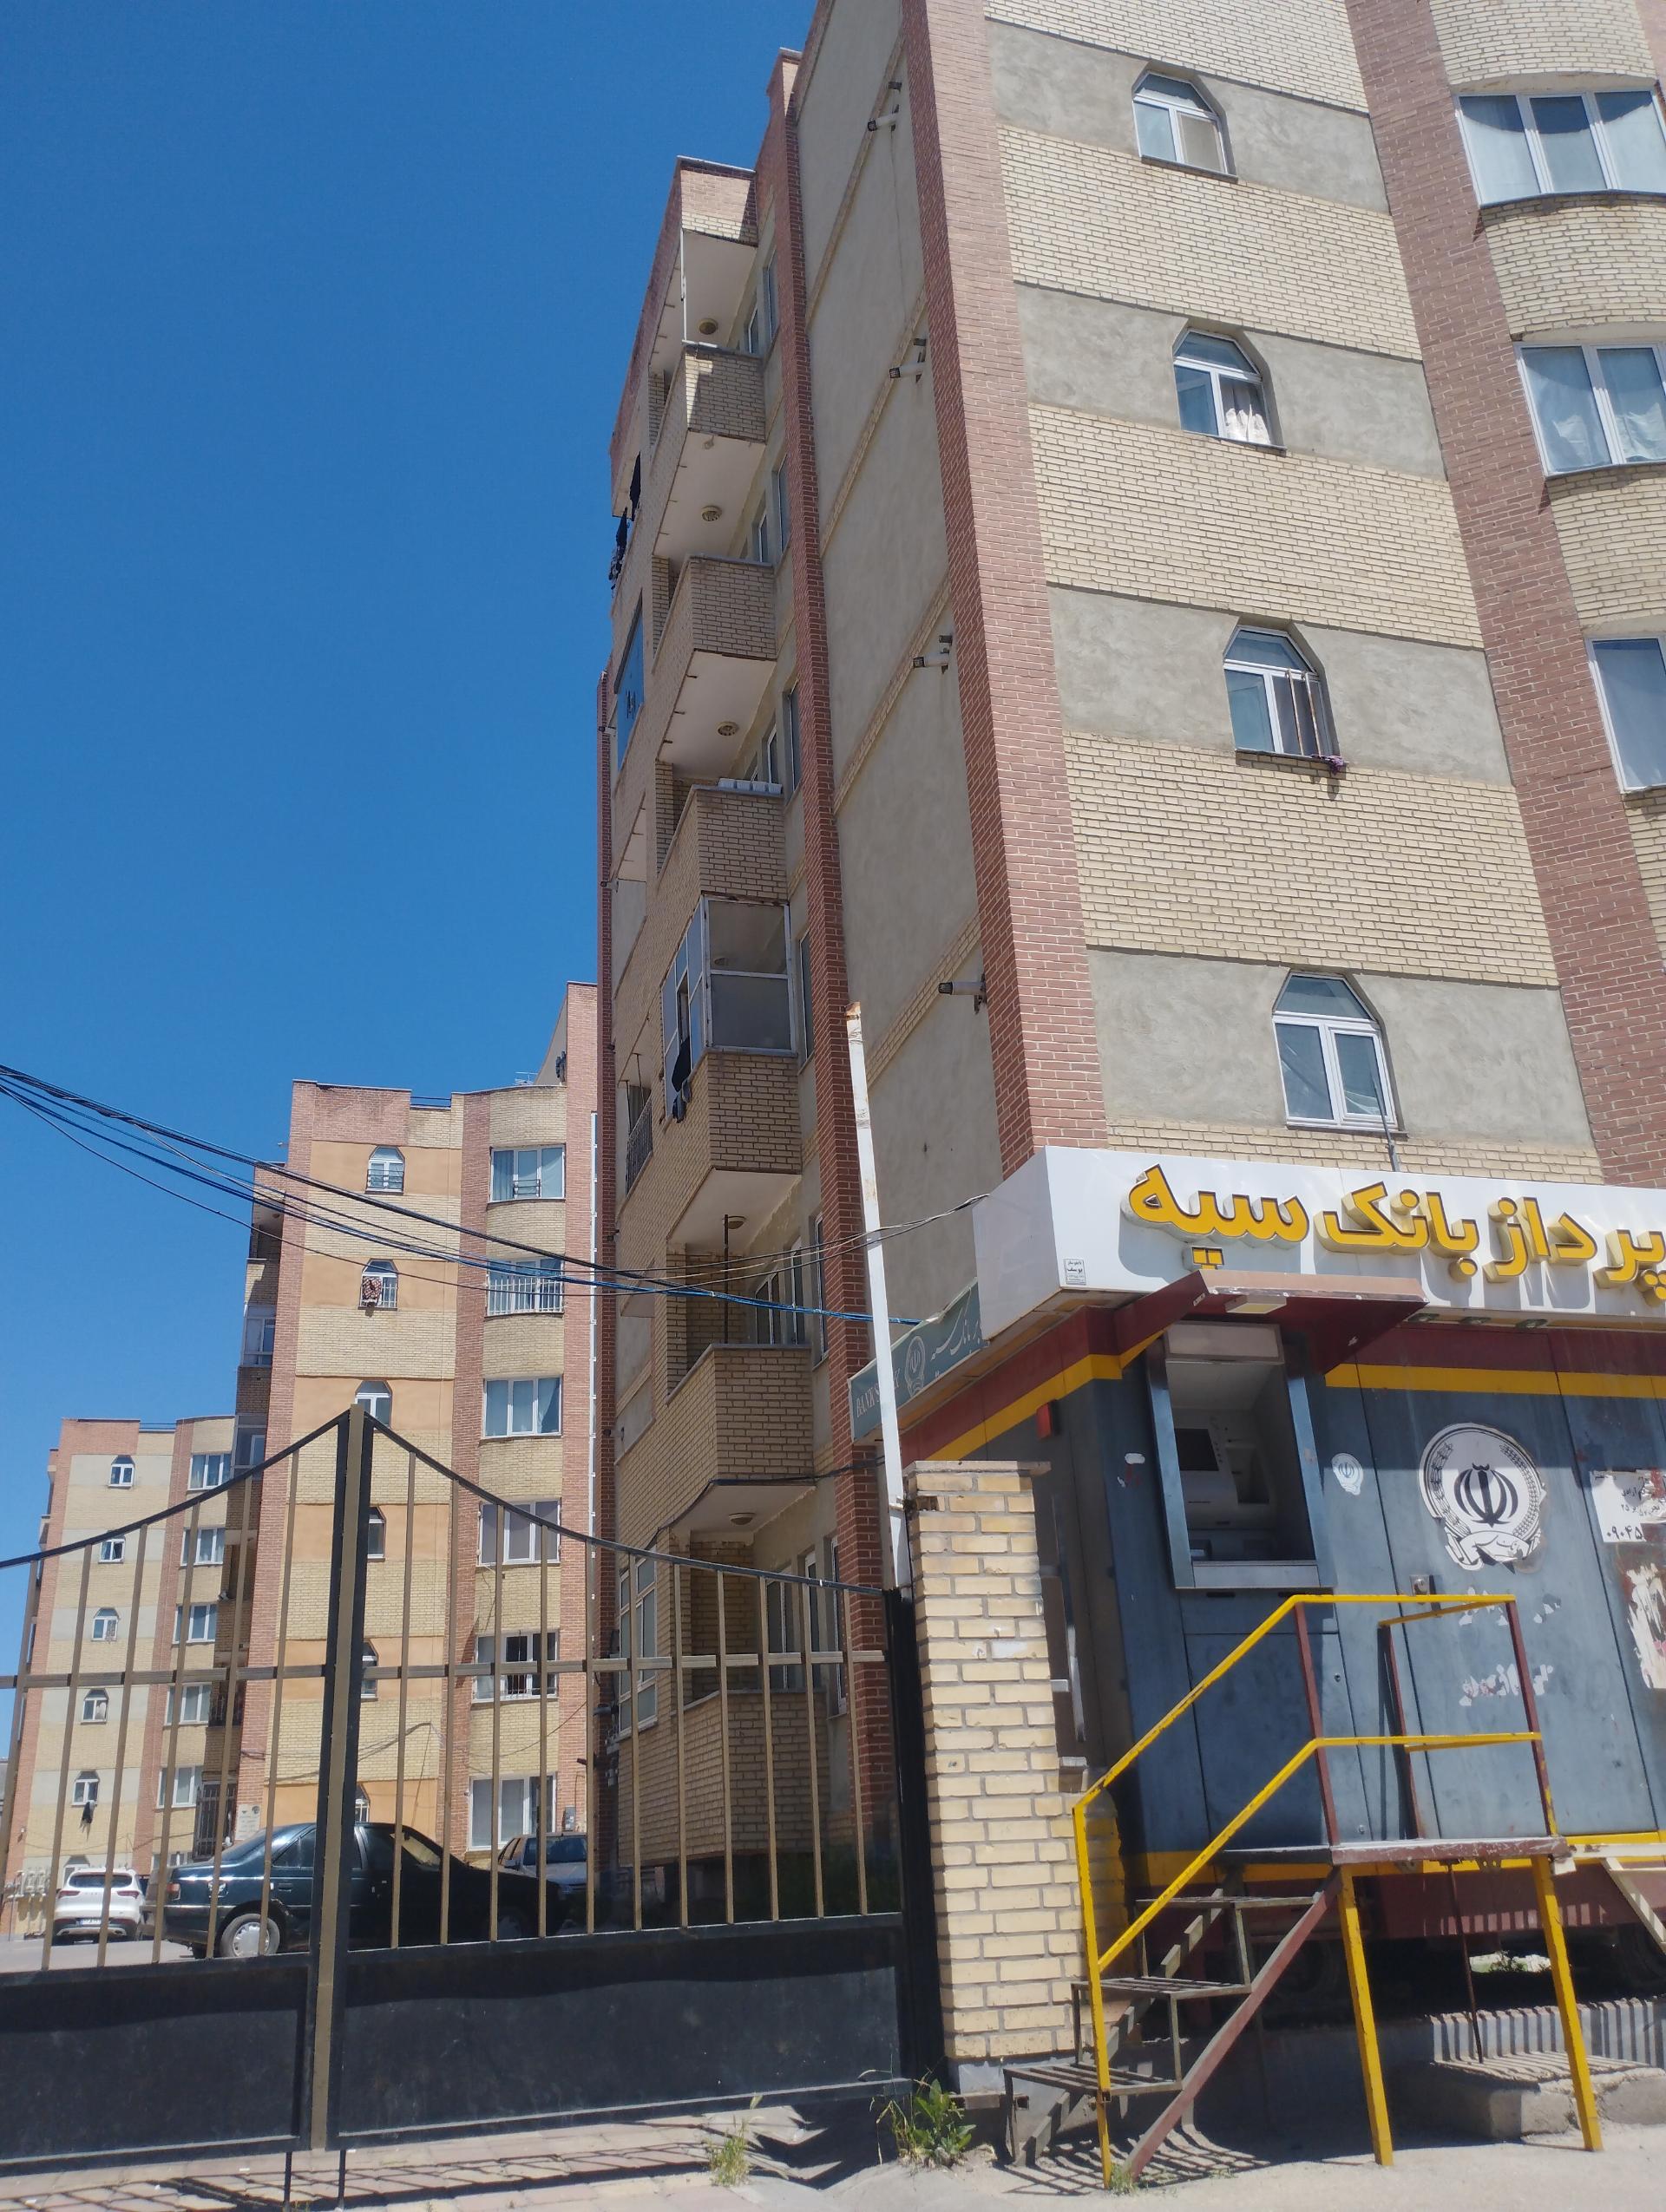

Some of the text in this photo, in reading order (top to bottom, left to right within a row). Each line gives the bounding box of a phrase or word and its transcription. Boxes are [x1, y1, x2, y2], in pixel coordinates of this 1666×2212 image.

[1125, 1163, 1666, 1300] پرداز بانک سپه
[856, 1386, 876, 1418] BANK
